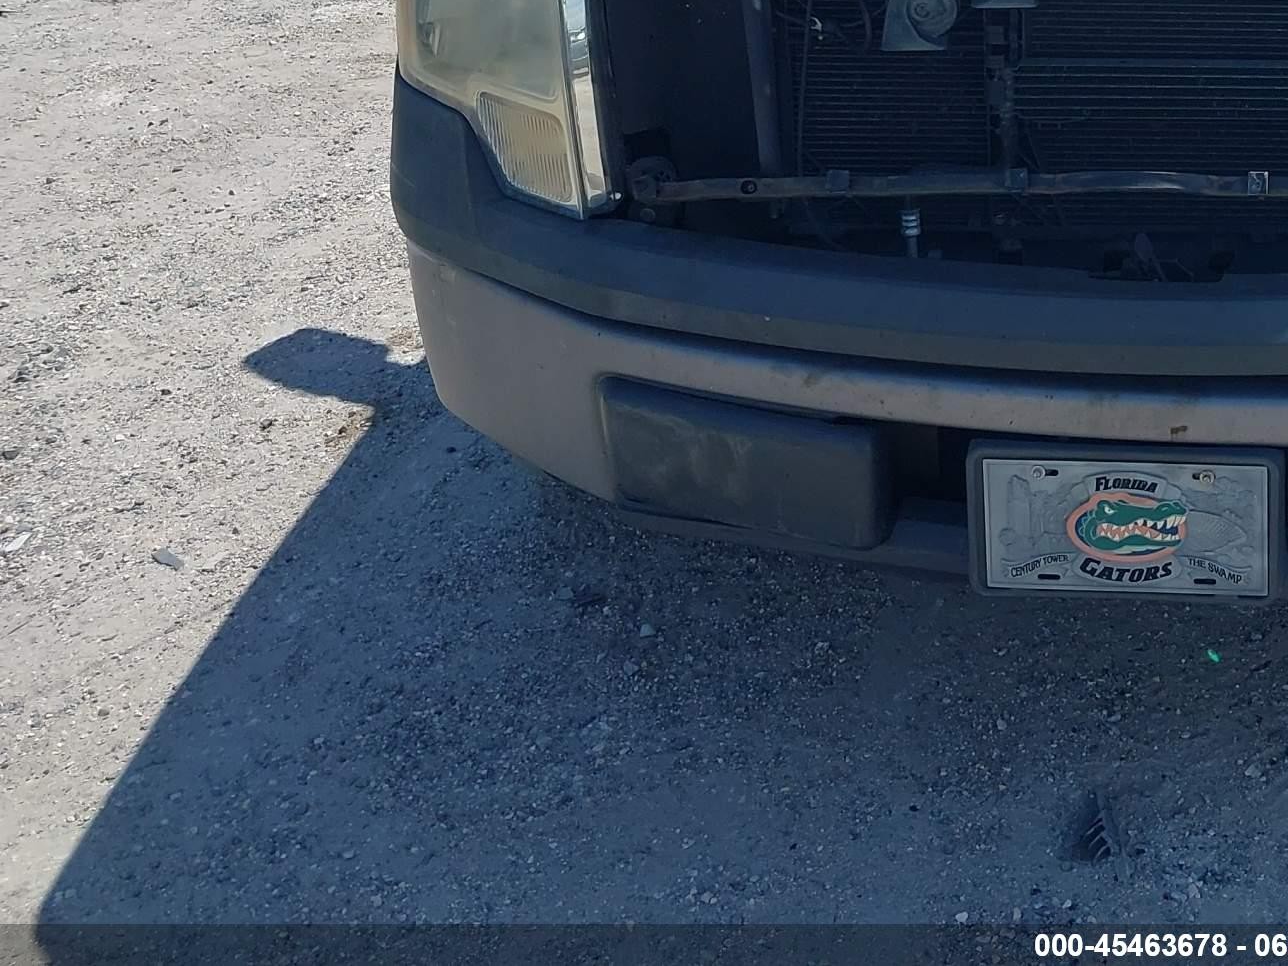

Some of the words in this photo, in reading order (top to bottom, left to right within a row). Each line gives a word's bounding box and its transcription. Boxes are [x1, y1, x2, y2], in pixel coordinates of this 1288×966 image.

[1095, 476, 1158, 493] FLORIDA
[1010, 558, 1041, 578] CENTURY
[1042, 554, 1069, 566] TOWER
[1080, 557, 1172, 583] GATORS
[1188, 557, 1206, 569] THE
[1207, 562, 1243, 585] SWAMP
